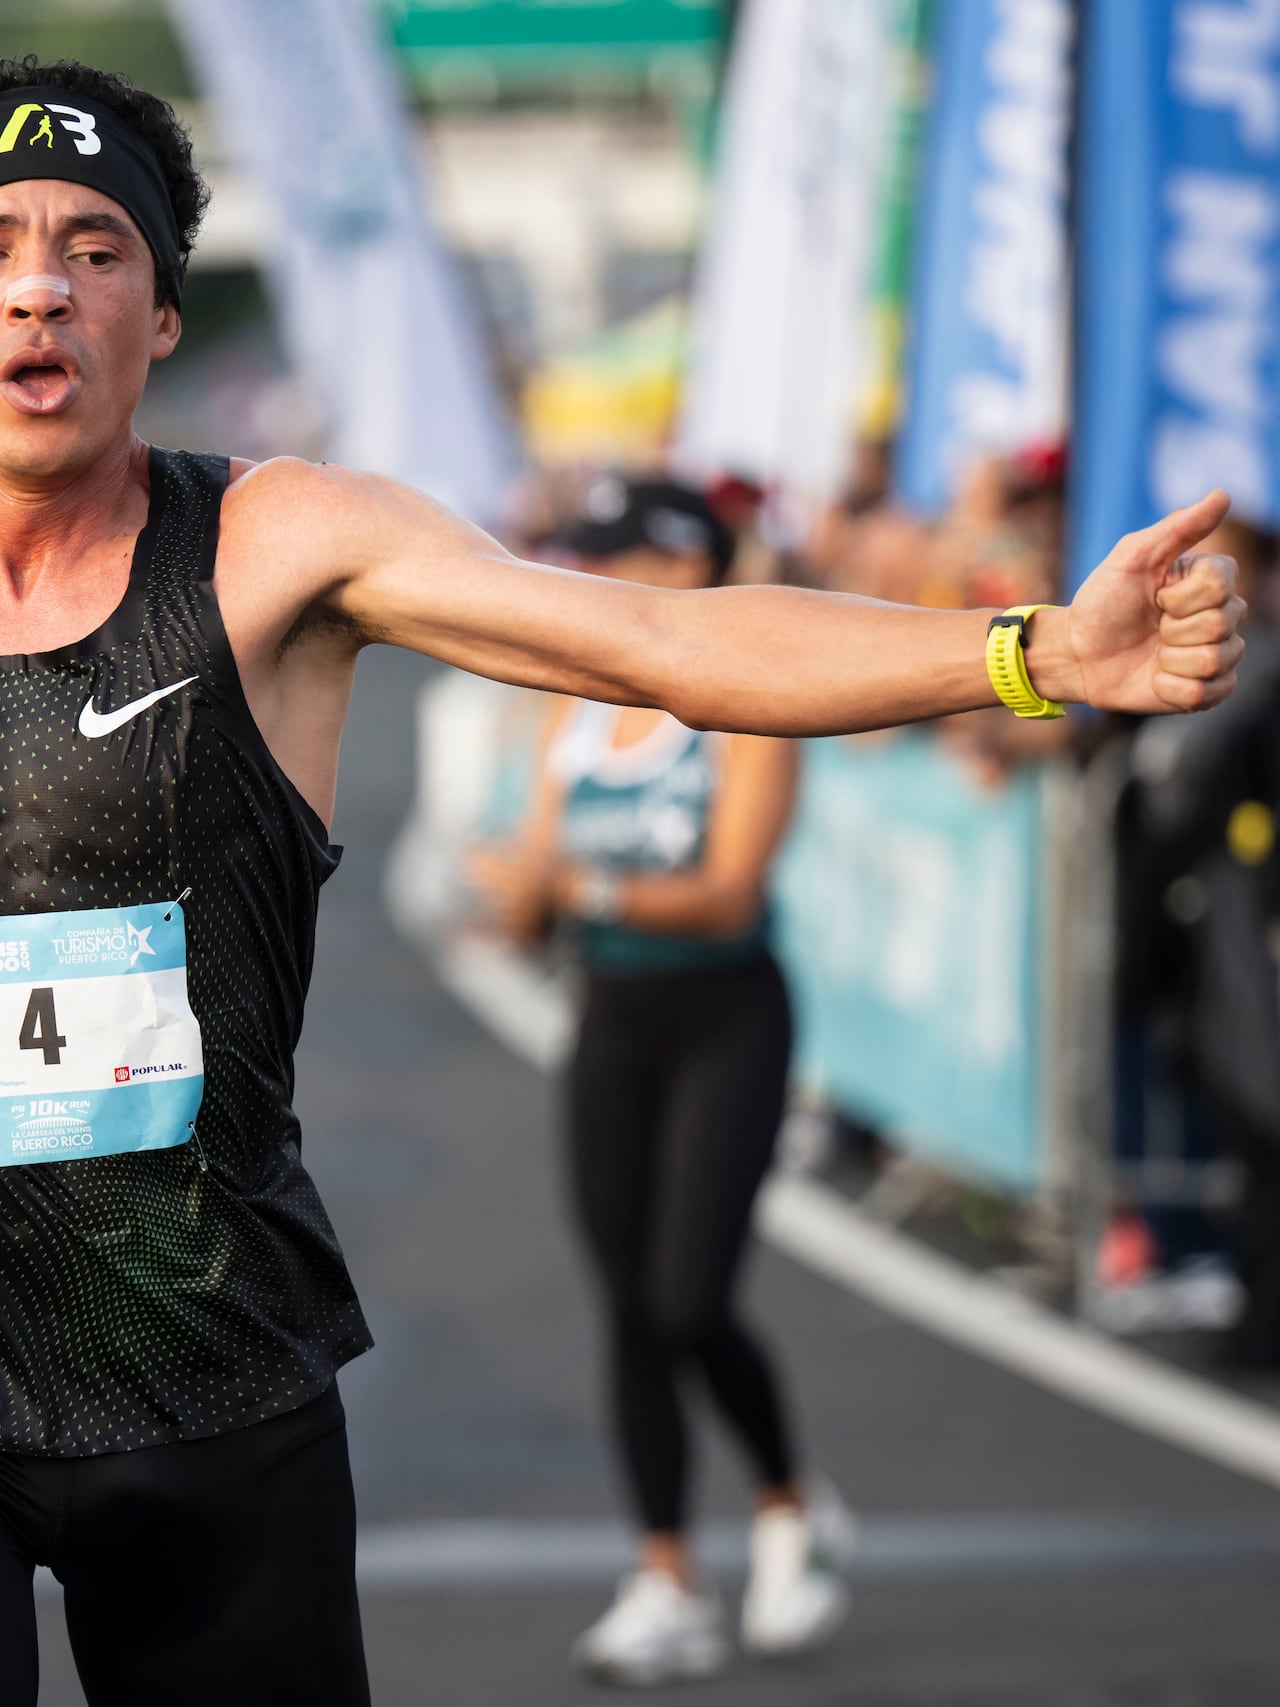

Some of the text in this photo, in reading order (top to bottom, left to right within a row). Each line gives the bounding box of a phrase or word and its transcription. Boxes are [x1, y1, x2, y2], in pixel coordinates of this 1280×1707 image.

[113, 926, 125, 935] DE
[51, 935, 126, 955] TURISMO
[59, 951, 128, 965] PUERTO RICO
[19, 987, 67, 1065] 4
[12, 1099, 91, 1117] PR 10K RUN
[11, 1131, 20, 1139] LA
[54, 1127, 66, 1135] DEL
[67, 1125, 92, 1134] PUENTE
[12, 1133, 94, 1152] PUERTO RICO
